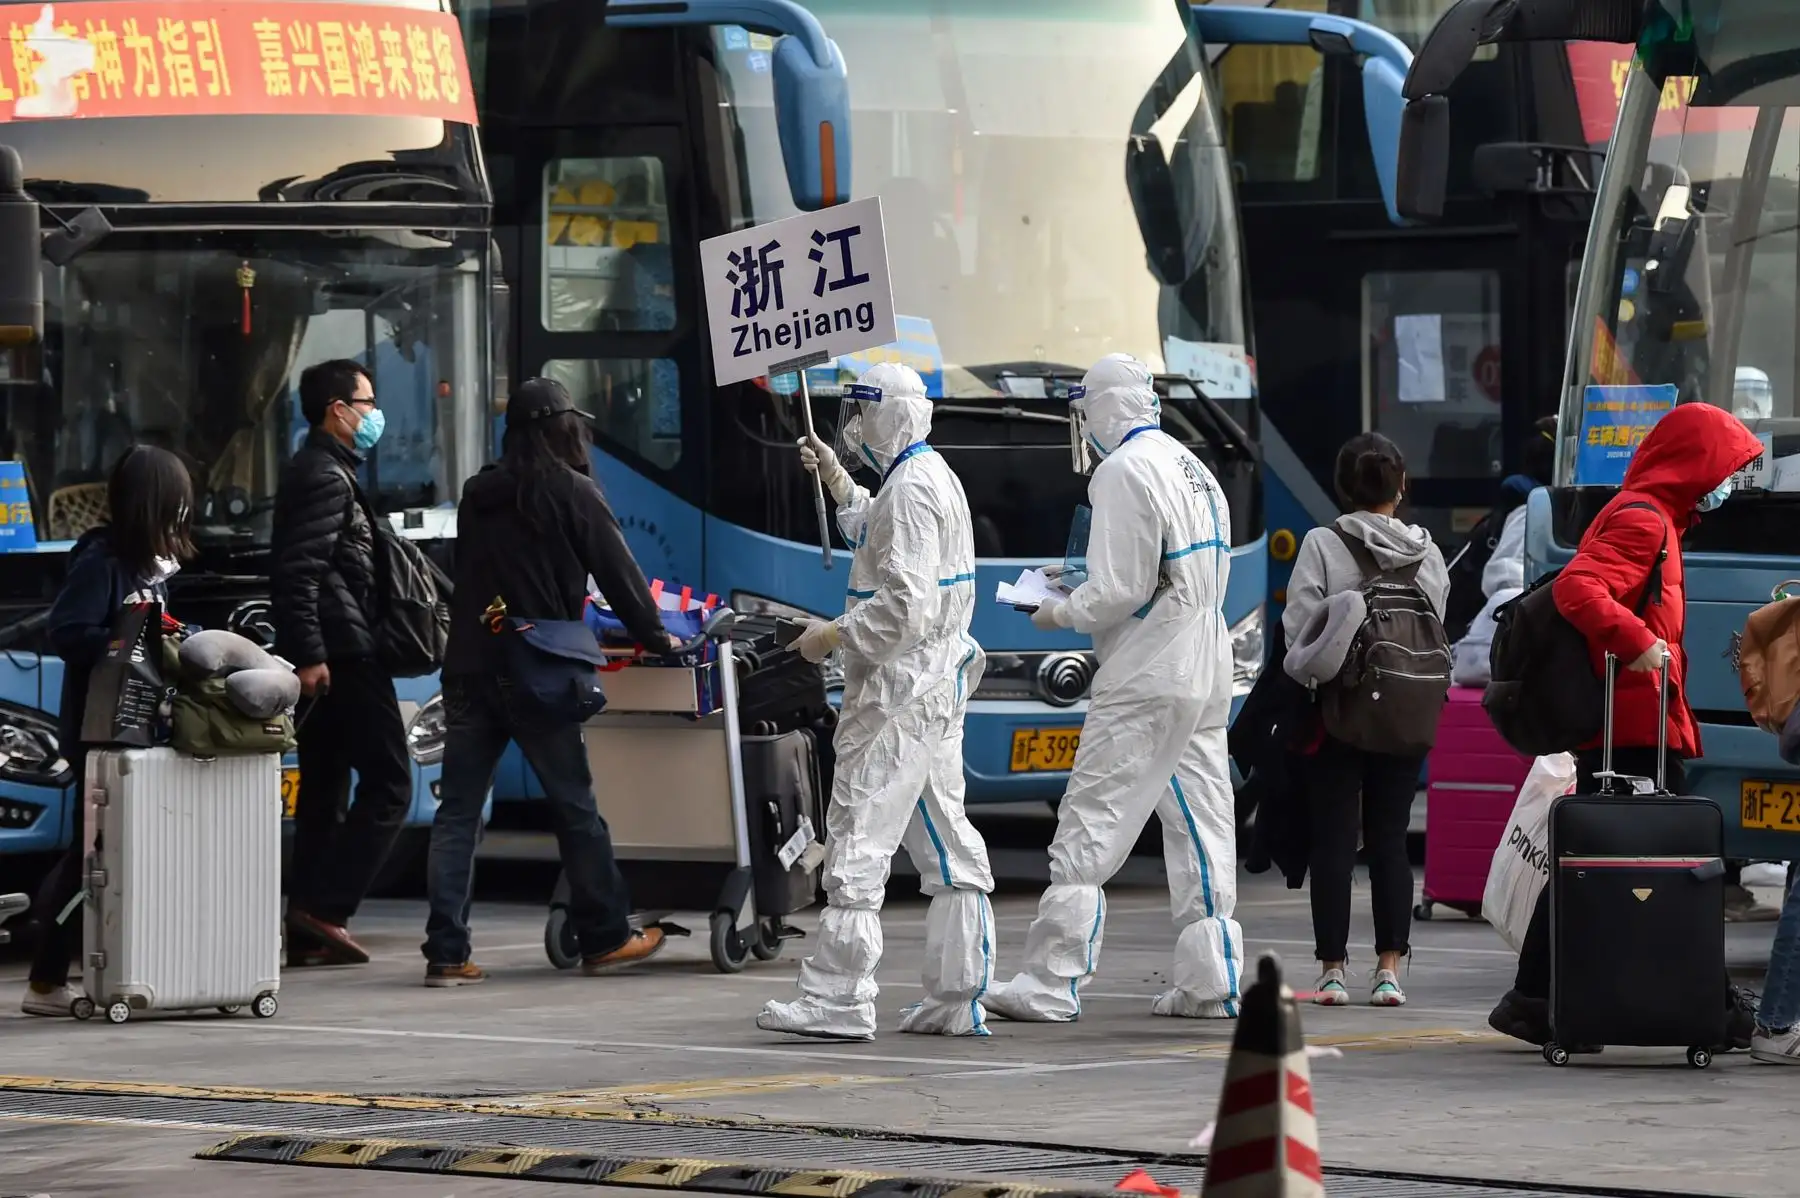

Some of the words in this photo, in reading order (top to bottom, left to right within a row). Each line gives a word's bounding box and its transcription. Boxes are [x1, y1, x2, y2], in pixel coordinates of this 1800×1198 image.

[253, 17, 461, 104] 嘉兴国鸿来接您
[725, 225, 870, 318] 浙江
[731, 301, 875, 357] Zhejiang
